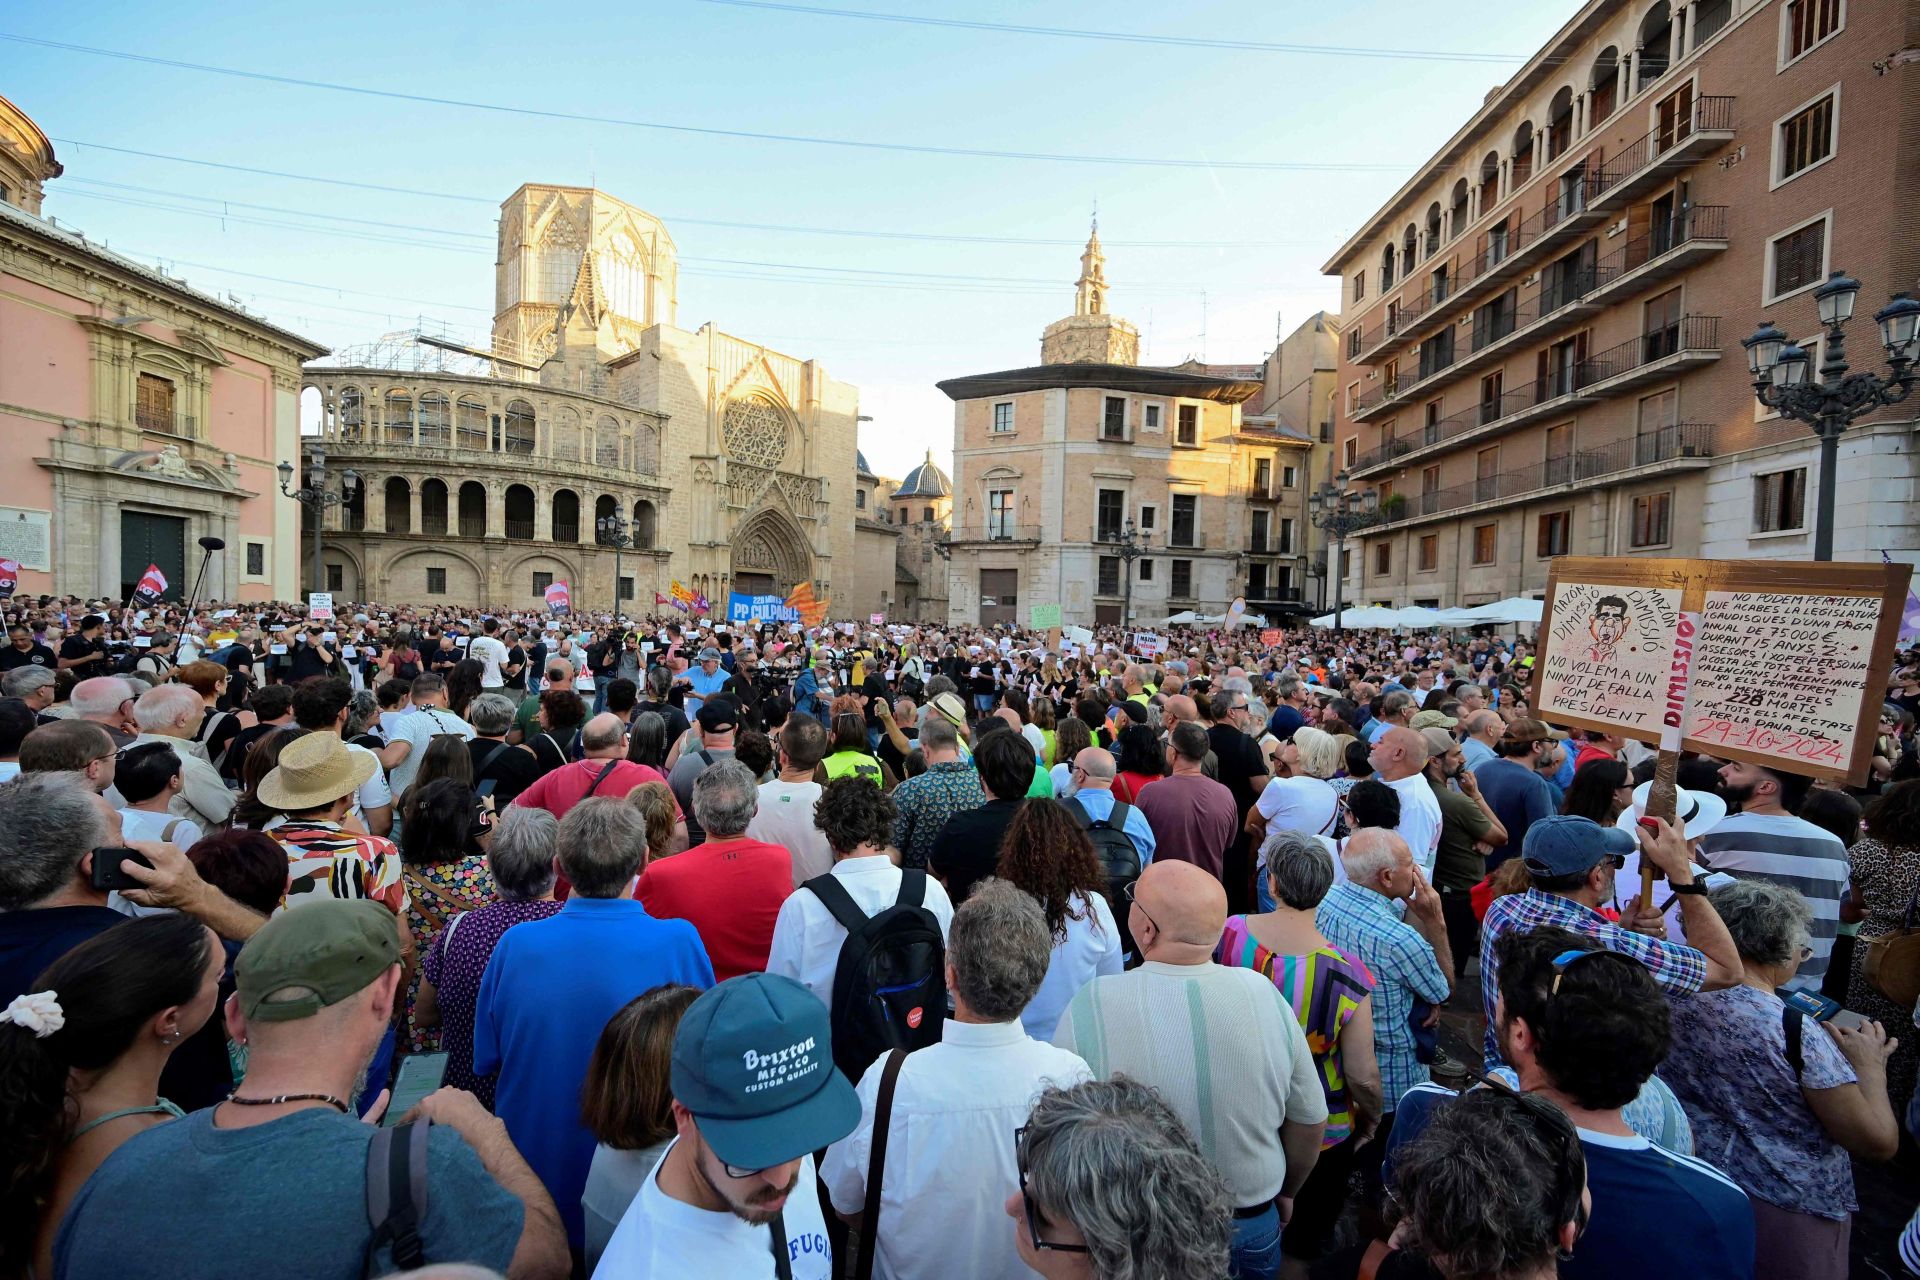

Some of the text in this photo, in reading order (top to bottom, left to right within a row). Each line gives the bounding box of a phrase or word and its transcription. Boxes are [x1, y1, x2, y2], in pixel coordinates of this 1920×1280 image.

[1553, 585, 1585, 614] MAZÓN
[1647, 588, 1677, 628] MAZÓN
[1706, 600, 1730, 610] QUE
[1733, 603, 1780, 614] ACABES
[1784, 606, 1800, 614] LA
[1731, 593, 1752, 602] NO
[1756, 593, 1804, 604] PODEM
[733, 602, 799, 621] PP CULPABLE
[1626, 590, 1667, 653] DIMISSIÓ
[1702, 622, 1739, 633] ANUAL
[1746, 625, 1765, 635] DE
[1791, 617, 1831, 629] D'UNA
[1834, 620, 1873, 631] PAGA
[1698, 643, 1756, 660] ASSESORS
[1700, 632, 1752, 647] DURANT
[1753, 638, 1771, 649] 15
[1548, 655, 1657, 686] NO VOLEM A UN
[1697, 664, 1770, 679] VALENCIANS
[1782, 673, 1868, 690] VALENCIANES
[1742, 659, 1761, 668] DE
[1764, 661, 1791, 672] TOTS
[1796, 665, 1827, 675] ELS
[1546, 670, 1655, 702] NINOT DE FALLA
[1694, 678, 1716, 688] PER
[1735, 685, 1788, 699] MEMORIA
[1794, 694, 1833, 706] DELS
[1734, 676, 1758, 685] ELS
[1561, 686, 1606, 702] COM A
[1725, 692, 1764, 707] 228
[1552, 695, 1648, 724] PRESIDENT
[1708, 710, 1732, 722] PER
[1734, 715, 1750, 724] LA
[1754, 719, 1792, 733] DANA
[1724, 703, 1751, 715] TOTS
[1754, 709, 1778, 719] ELS
[1783, 713, 1854, 732] AFECTATS
[1691, 718, 1845, 764] 29-10-2024
[742, 1036, 816, 1071] Brixton
[745, 1062, 819, 1093] CUSTOM QUALITY
